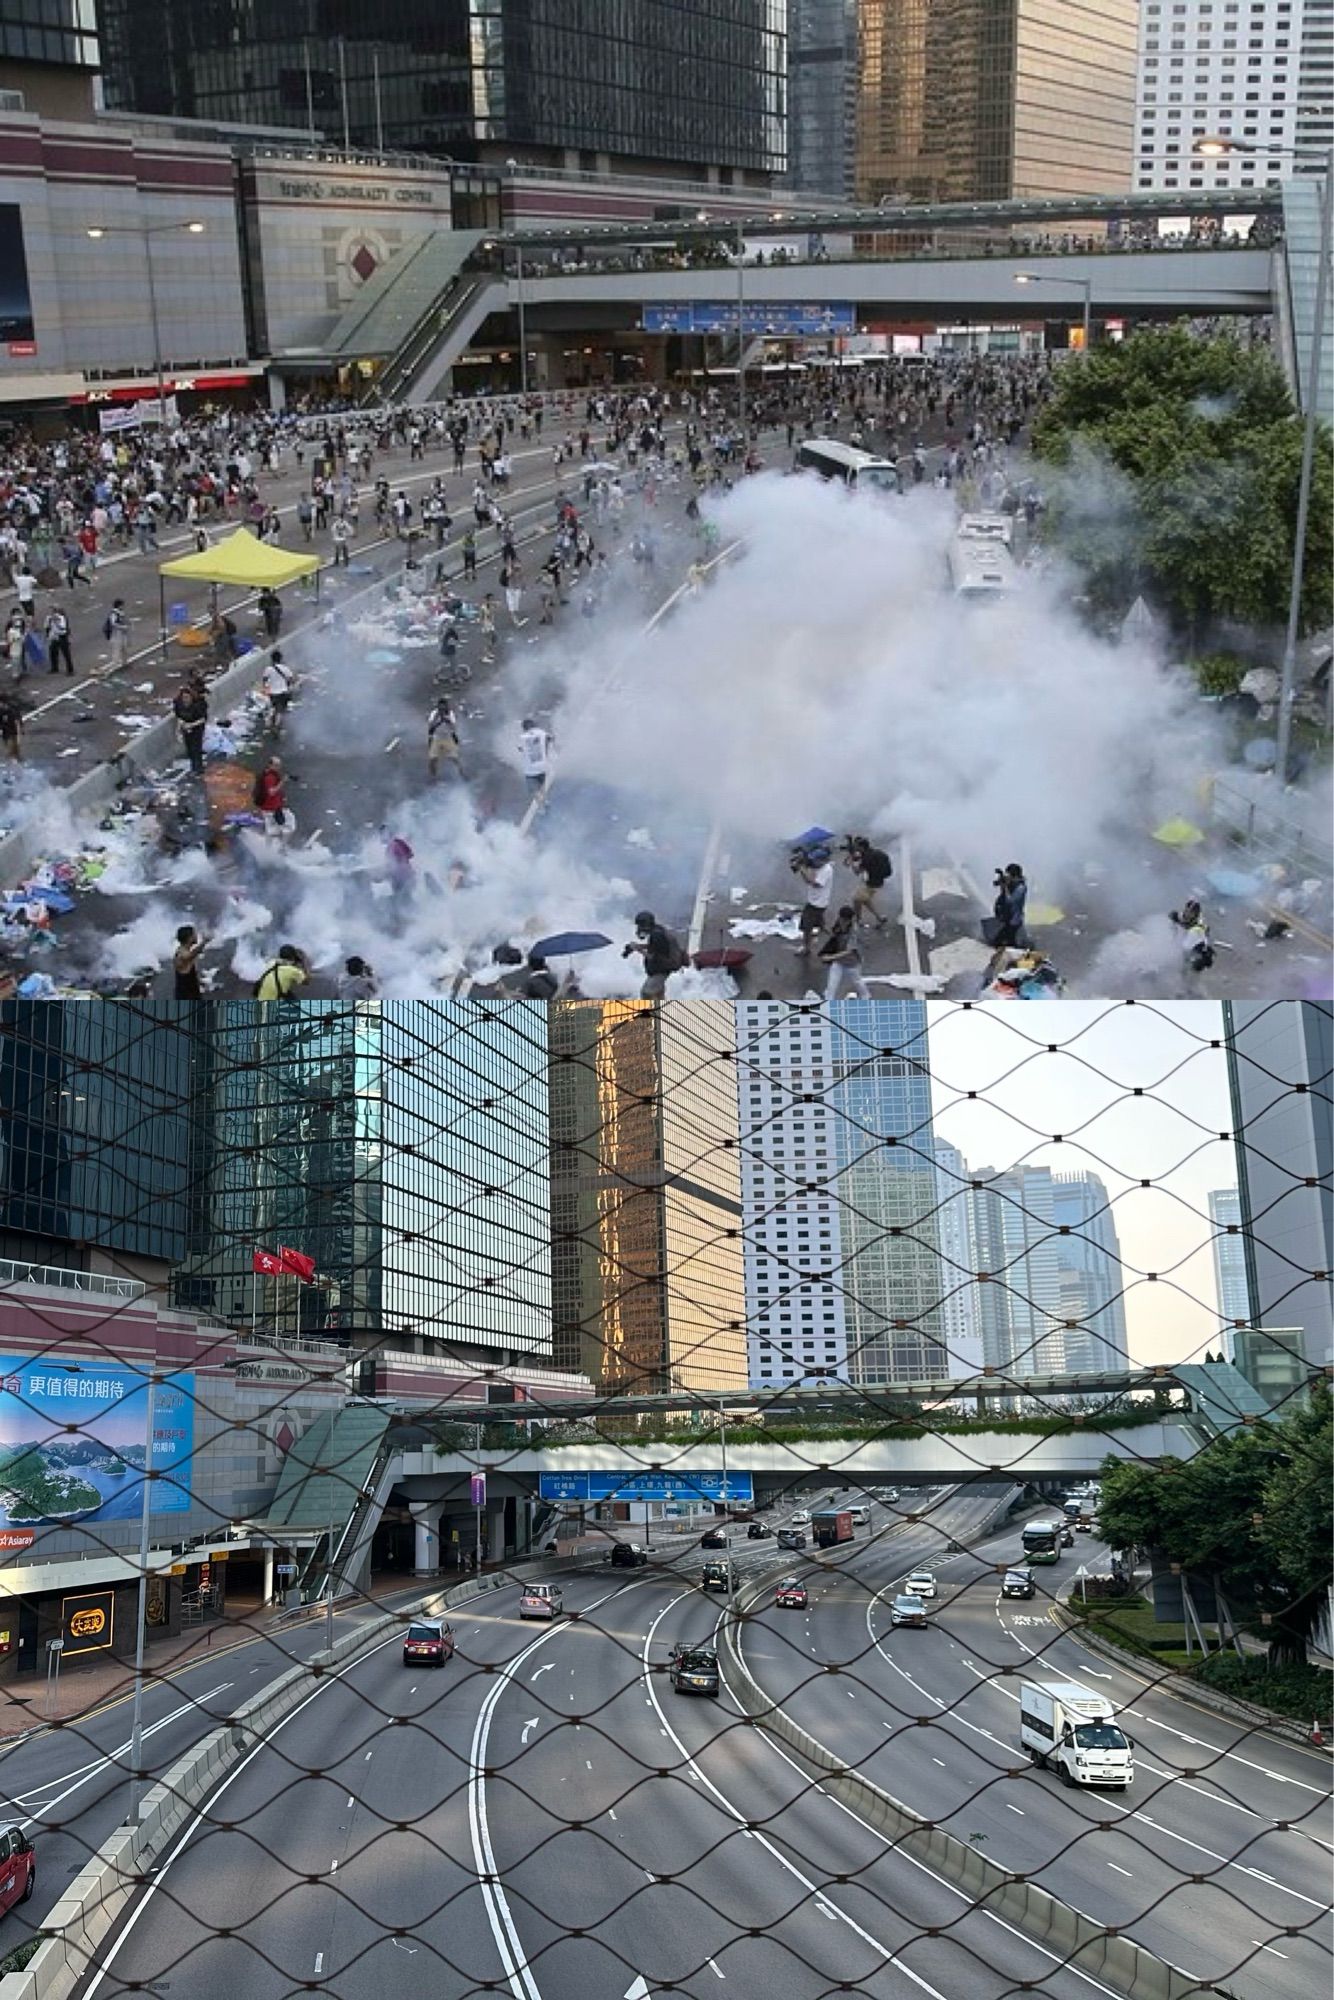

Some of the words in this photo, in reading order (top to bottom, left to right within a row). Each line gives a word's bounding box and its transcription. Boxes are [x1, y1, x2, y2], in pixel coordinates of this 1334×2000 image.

[29, 1375, 125, 1399] 更值得的期待
[8, 1535, 34, 1546] Asiaray
